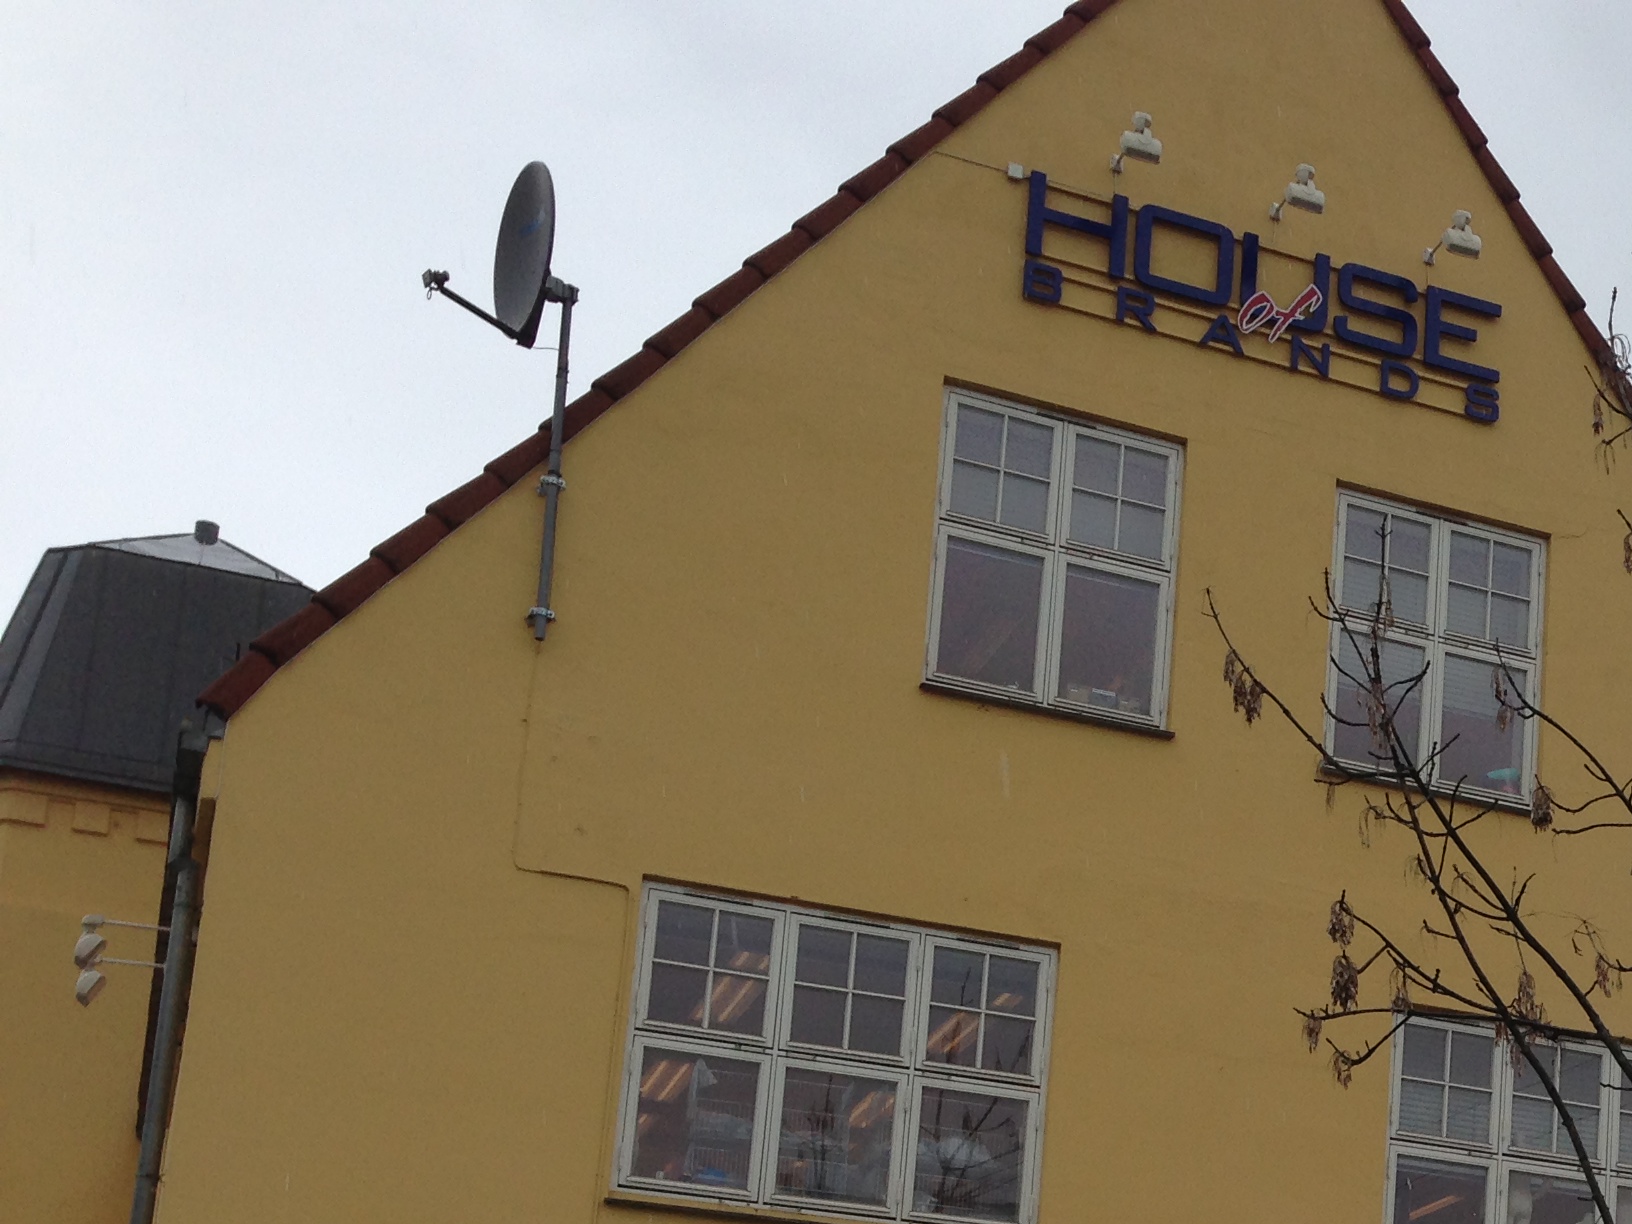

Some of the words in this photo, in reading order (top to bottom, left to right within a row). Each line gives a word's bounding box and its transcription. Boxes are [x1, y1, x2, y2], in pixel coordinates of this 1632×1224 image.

[1021, 258, 1500, 423] BRANDS
[1024, 169, 1502, 384] HOUSE
[1238, 284, 1322, 342] of
